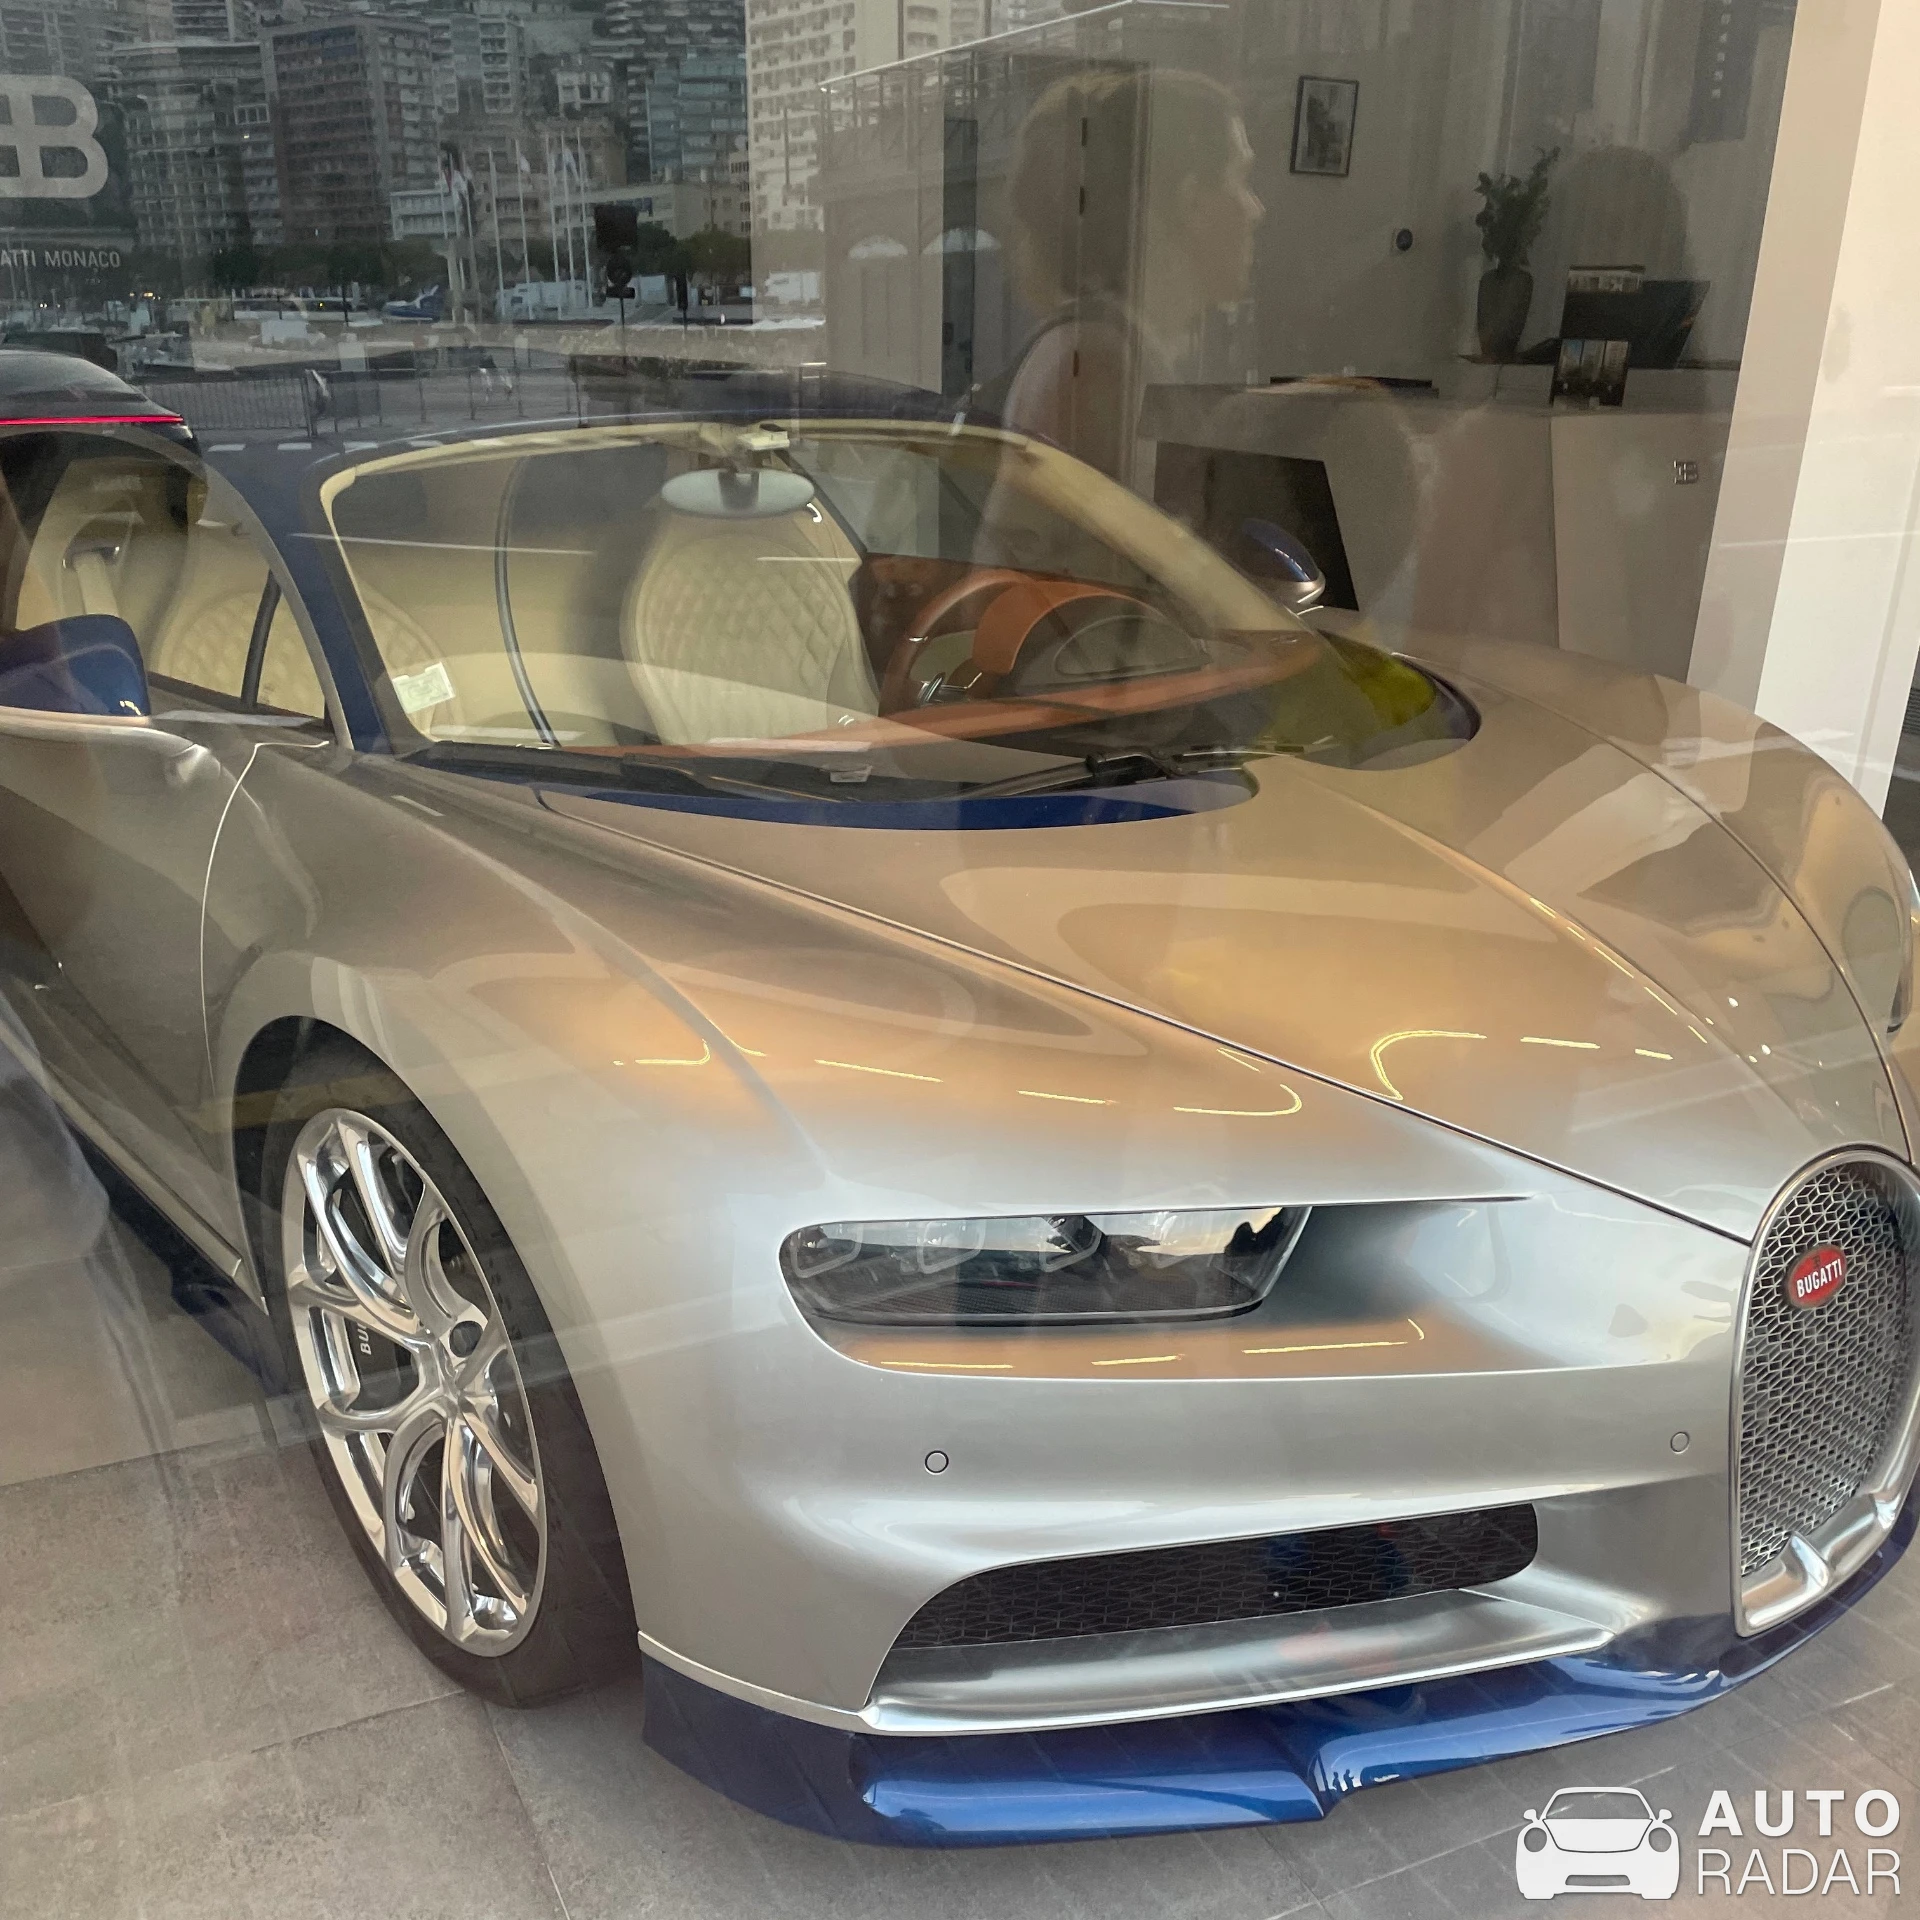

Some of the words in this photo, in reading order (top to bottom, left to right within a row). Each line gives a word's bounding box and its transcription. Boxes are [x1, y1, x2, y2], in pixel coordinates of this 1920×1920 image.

[0, 249, 37, 267] ATTI
[45, 249, 121, 269] MONACO
[1796, 1258, 1843, 1299] BUGATTI
